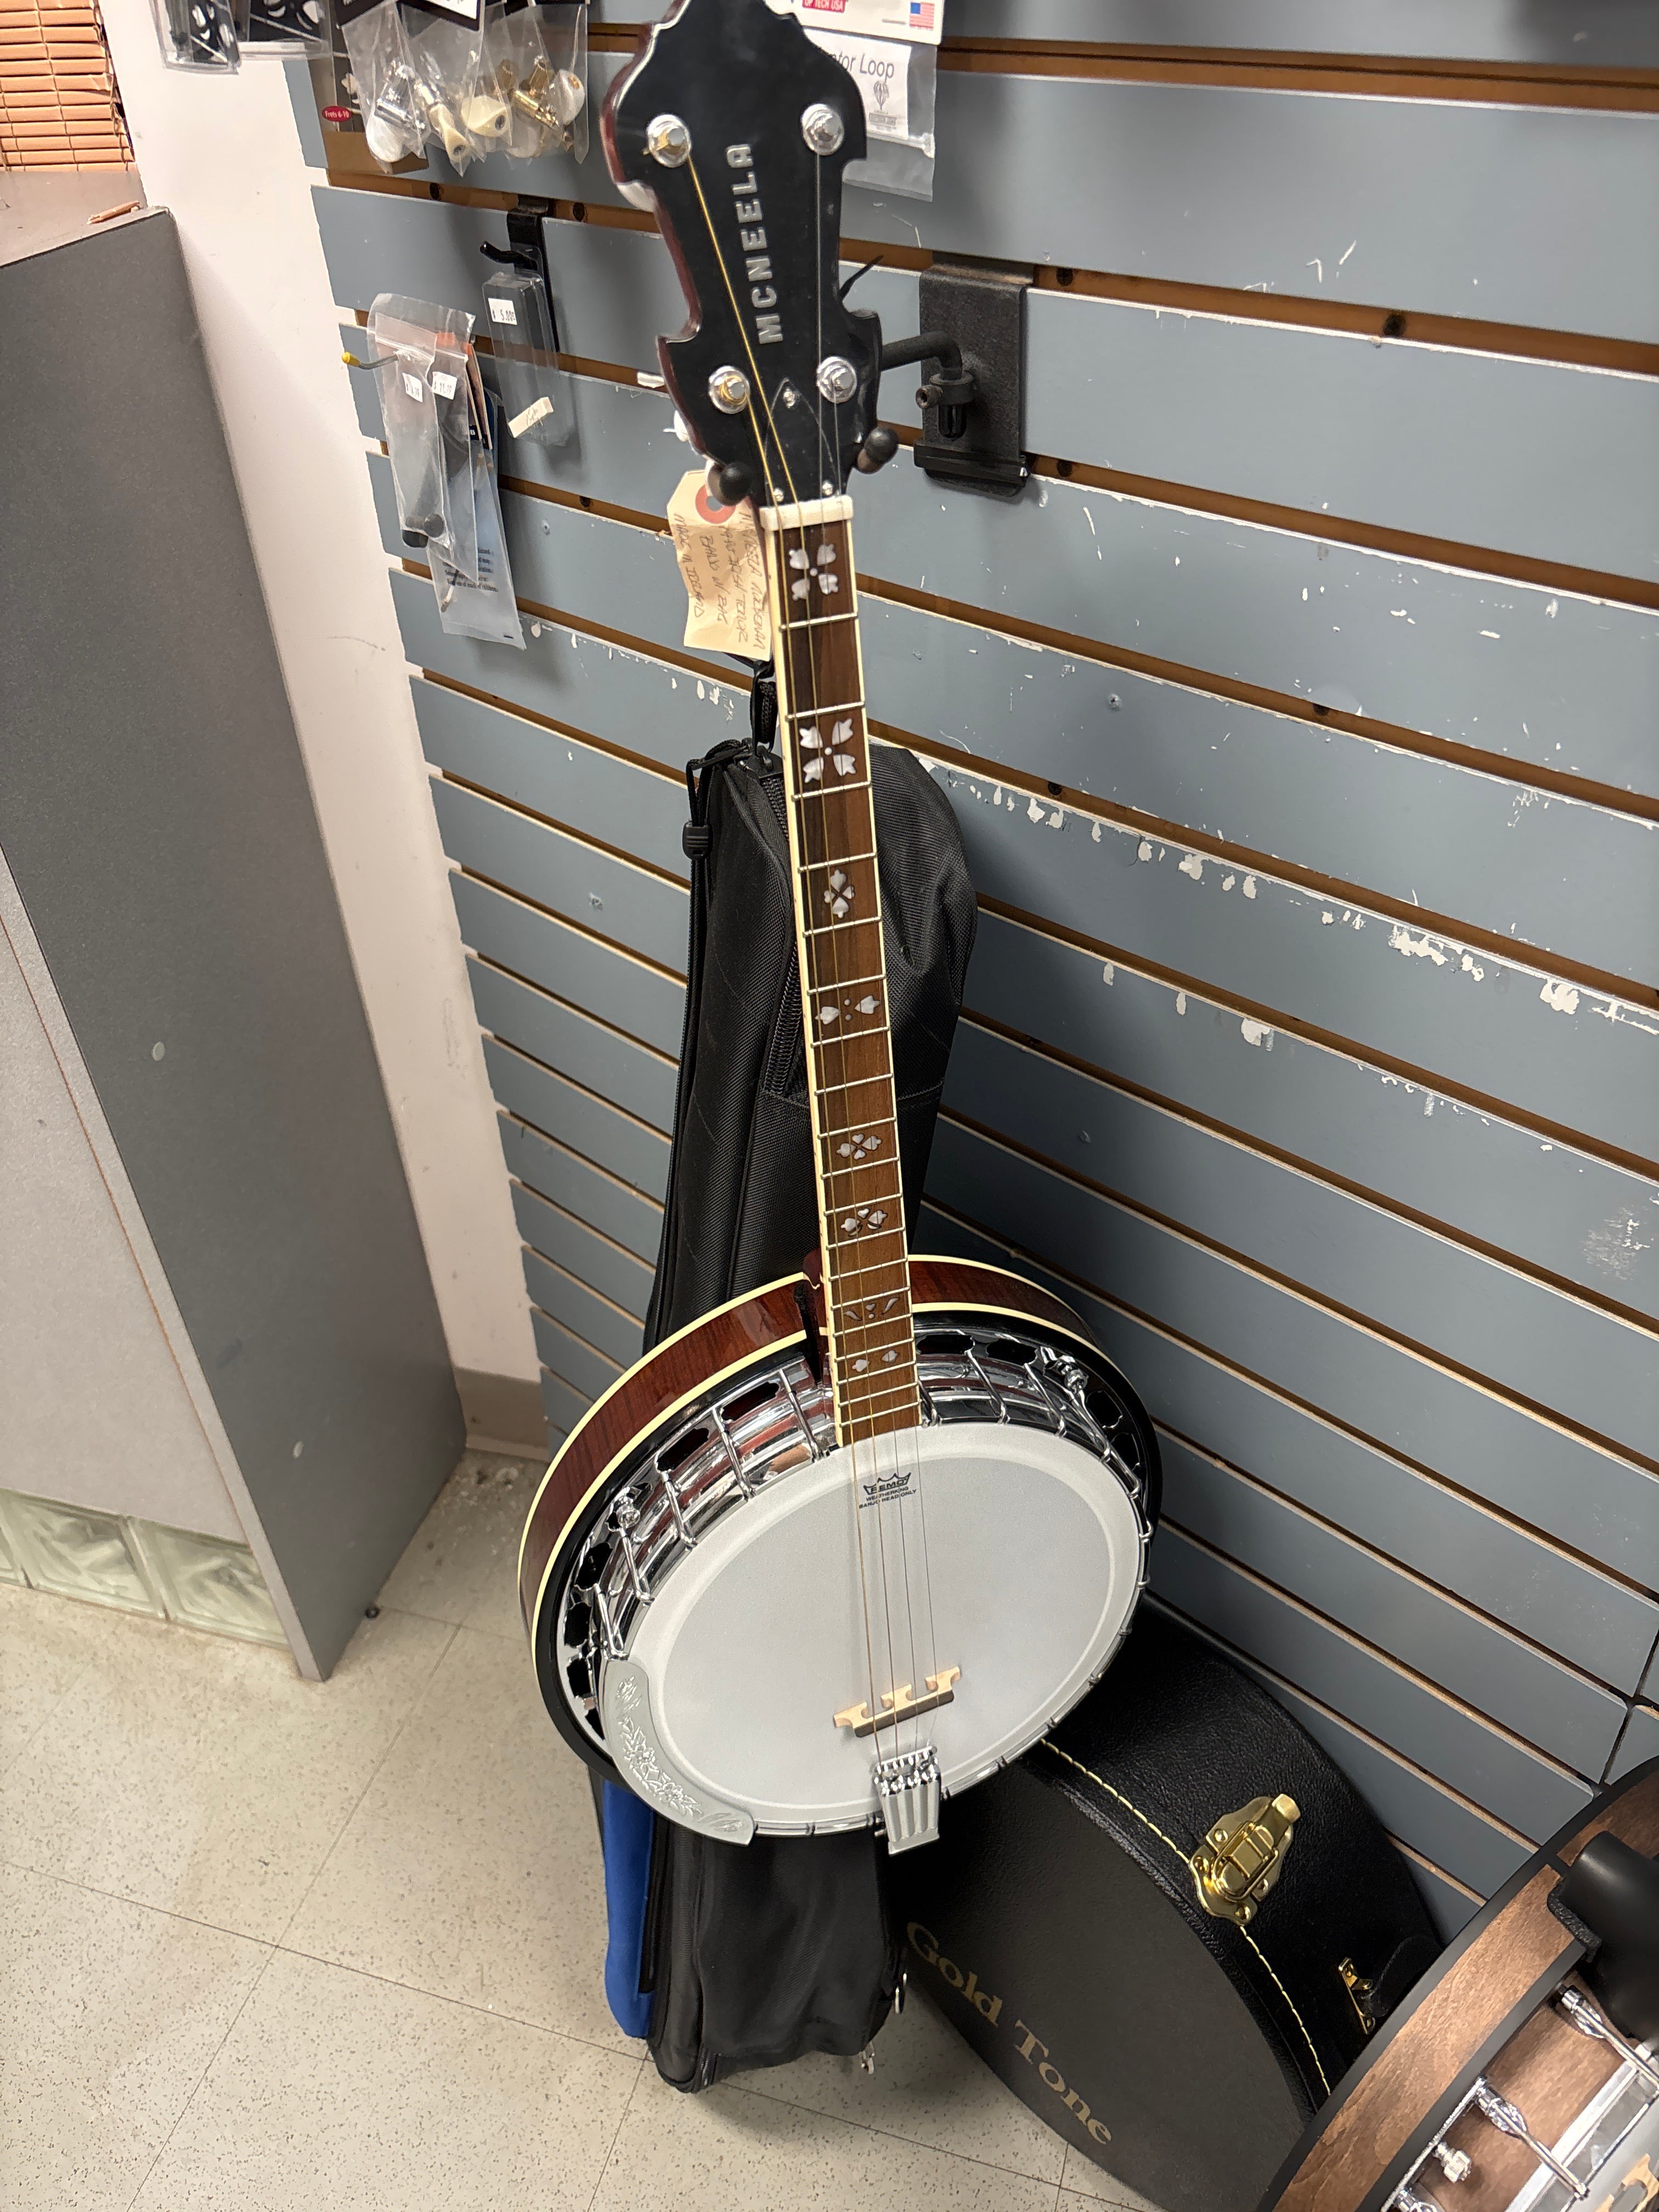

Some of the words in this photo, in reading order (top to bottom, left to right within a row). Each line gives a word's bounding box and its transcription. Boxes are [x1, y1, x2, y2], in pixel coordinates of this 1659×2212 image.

[860, 54, 894, 83] Loop
[725, 144, 783, 345] MCNEELA
[673, 512, 692, 550] MADE
[717, 594, 729, 625] BAG
[735, 593, 749, 644] TENOR
[859, 1498, 881, 1509] BANJO
[881, 1494, 900, 1503] HEAD
[900, 1488, 917, 1497] ONLY
[866, 1486, 909, 1502] WEATHERKING
[906, 1921, 1003, 2028] Gold
[1013, 2019, 1112, 2146] Tone
